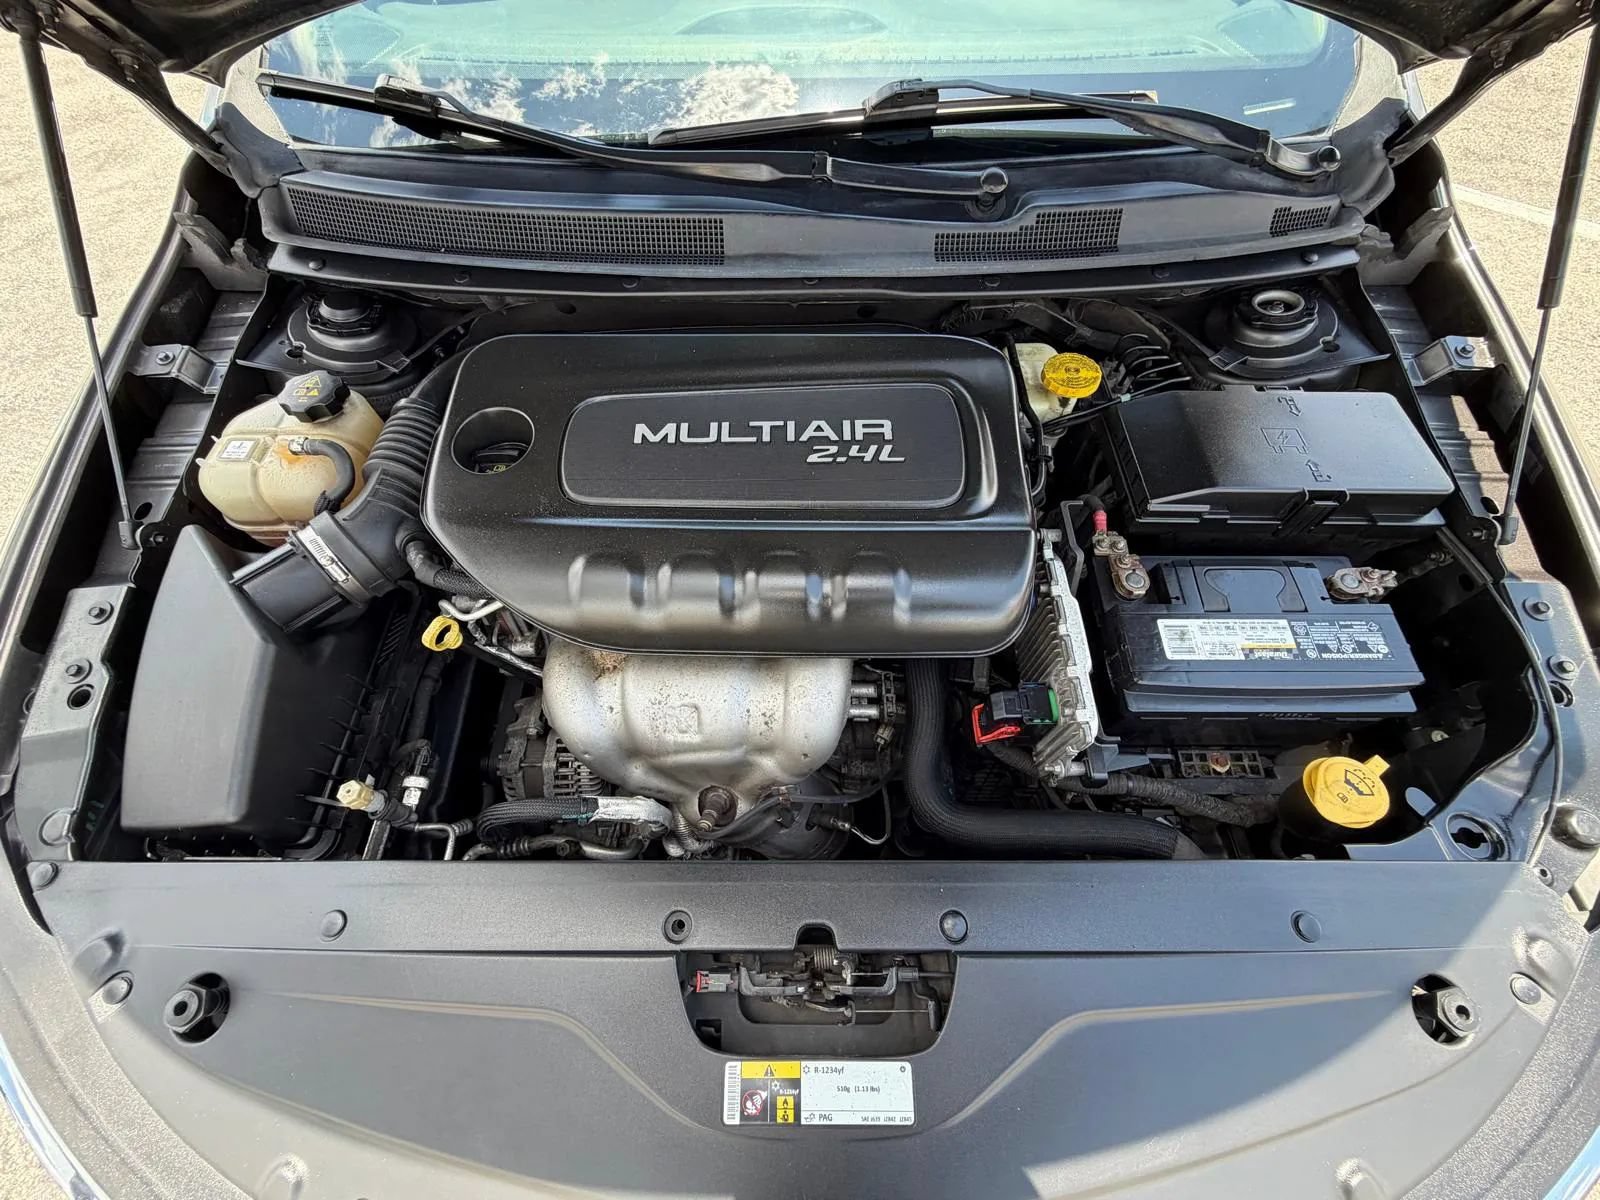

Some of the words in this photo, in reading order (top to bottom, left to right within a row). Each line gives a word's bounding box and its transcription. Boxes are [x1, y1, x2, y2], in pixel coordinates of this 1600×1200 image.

[633, 419, 894, 445] MULTIAIR
[806, 444, 906, 463] 2.4L
[814, 1066, 845, 1075] R-1234yf
[836, 1085, 851, 1093] 510g
[818, 1114, 833, 1122] PAG
